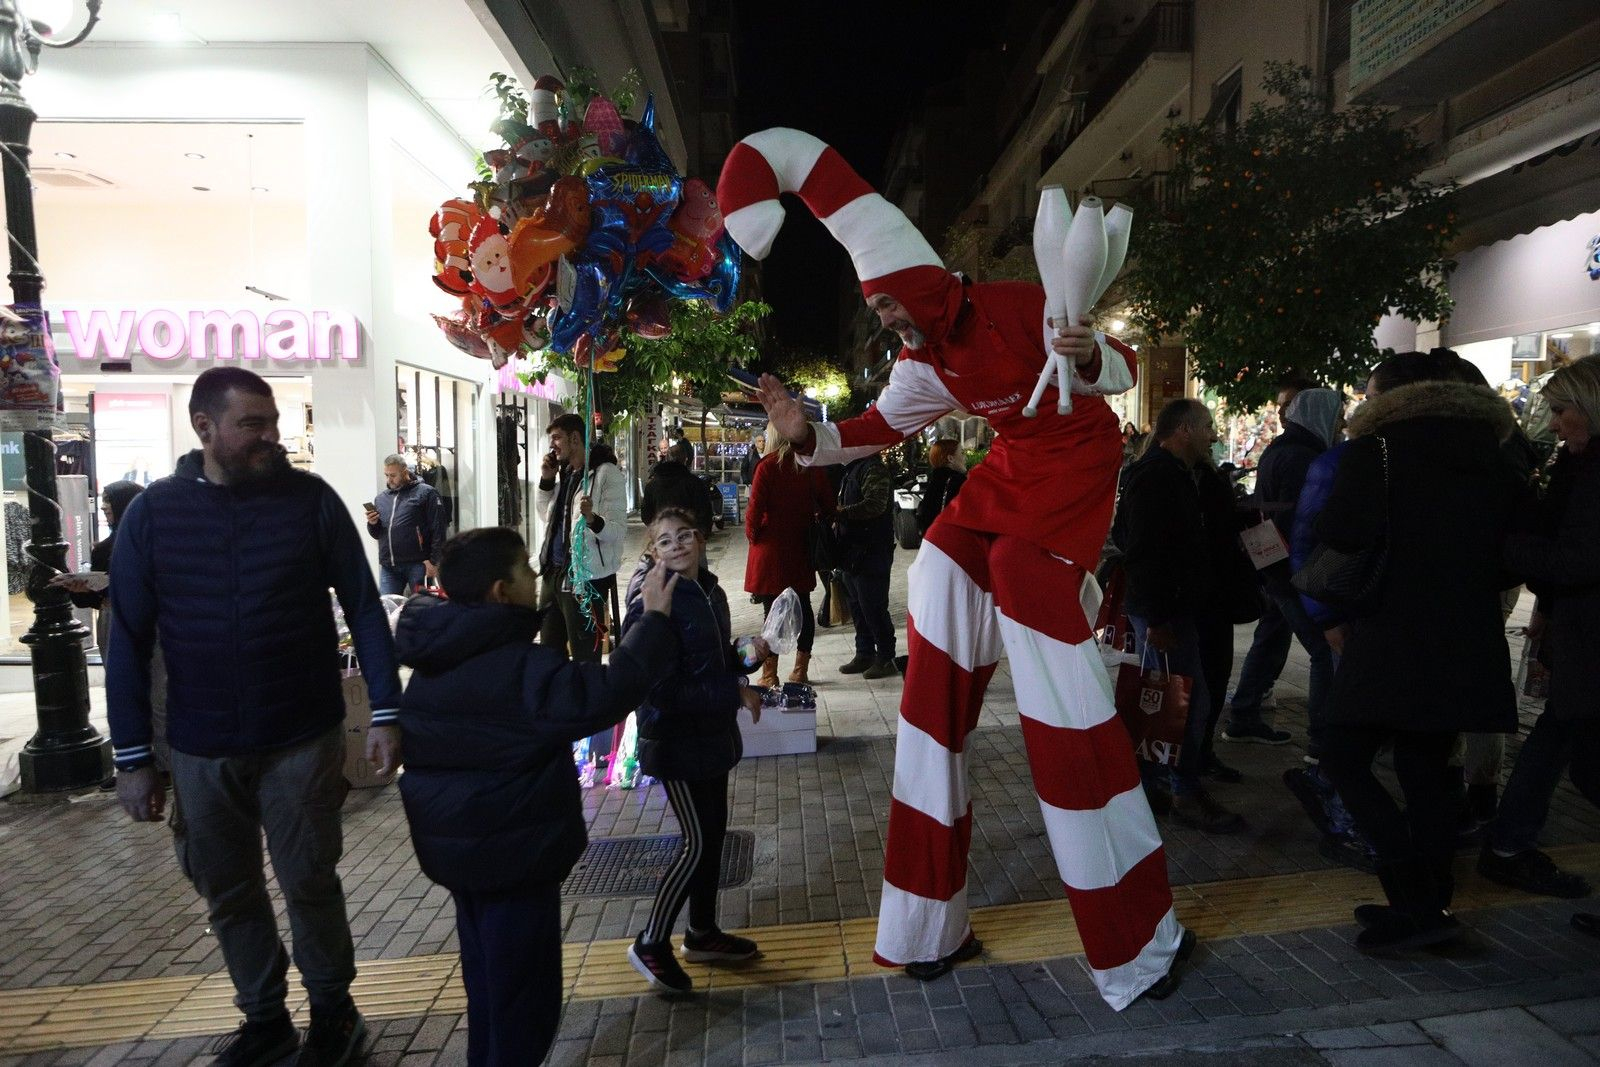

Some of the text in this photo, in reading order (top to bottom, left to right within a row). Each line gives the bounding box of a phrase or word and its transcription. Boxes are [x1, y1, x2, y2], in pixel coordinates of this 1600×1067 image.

[62, 309, 360, 360] woman
[647, 417, 657, 473] ΤΣΑΓΚΑΡ
[1143, 690, 1160, 704] 50
